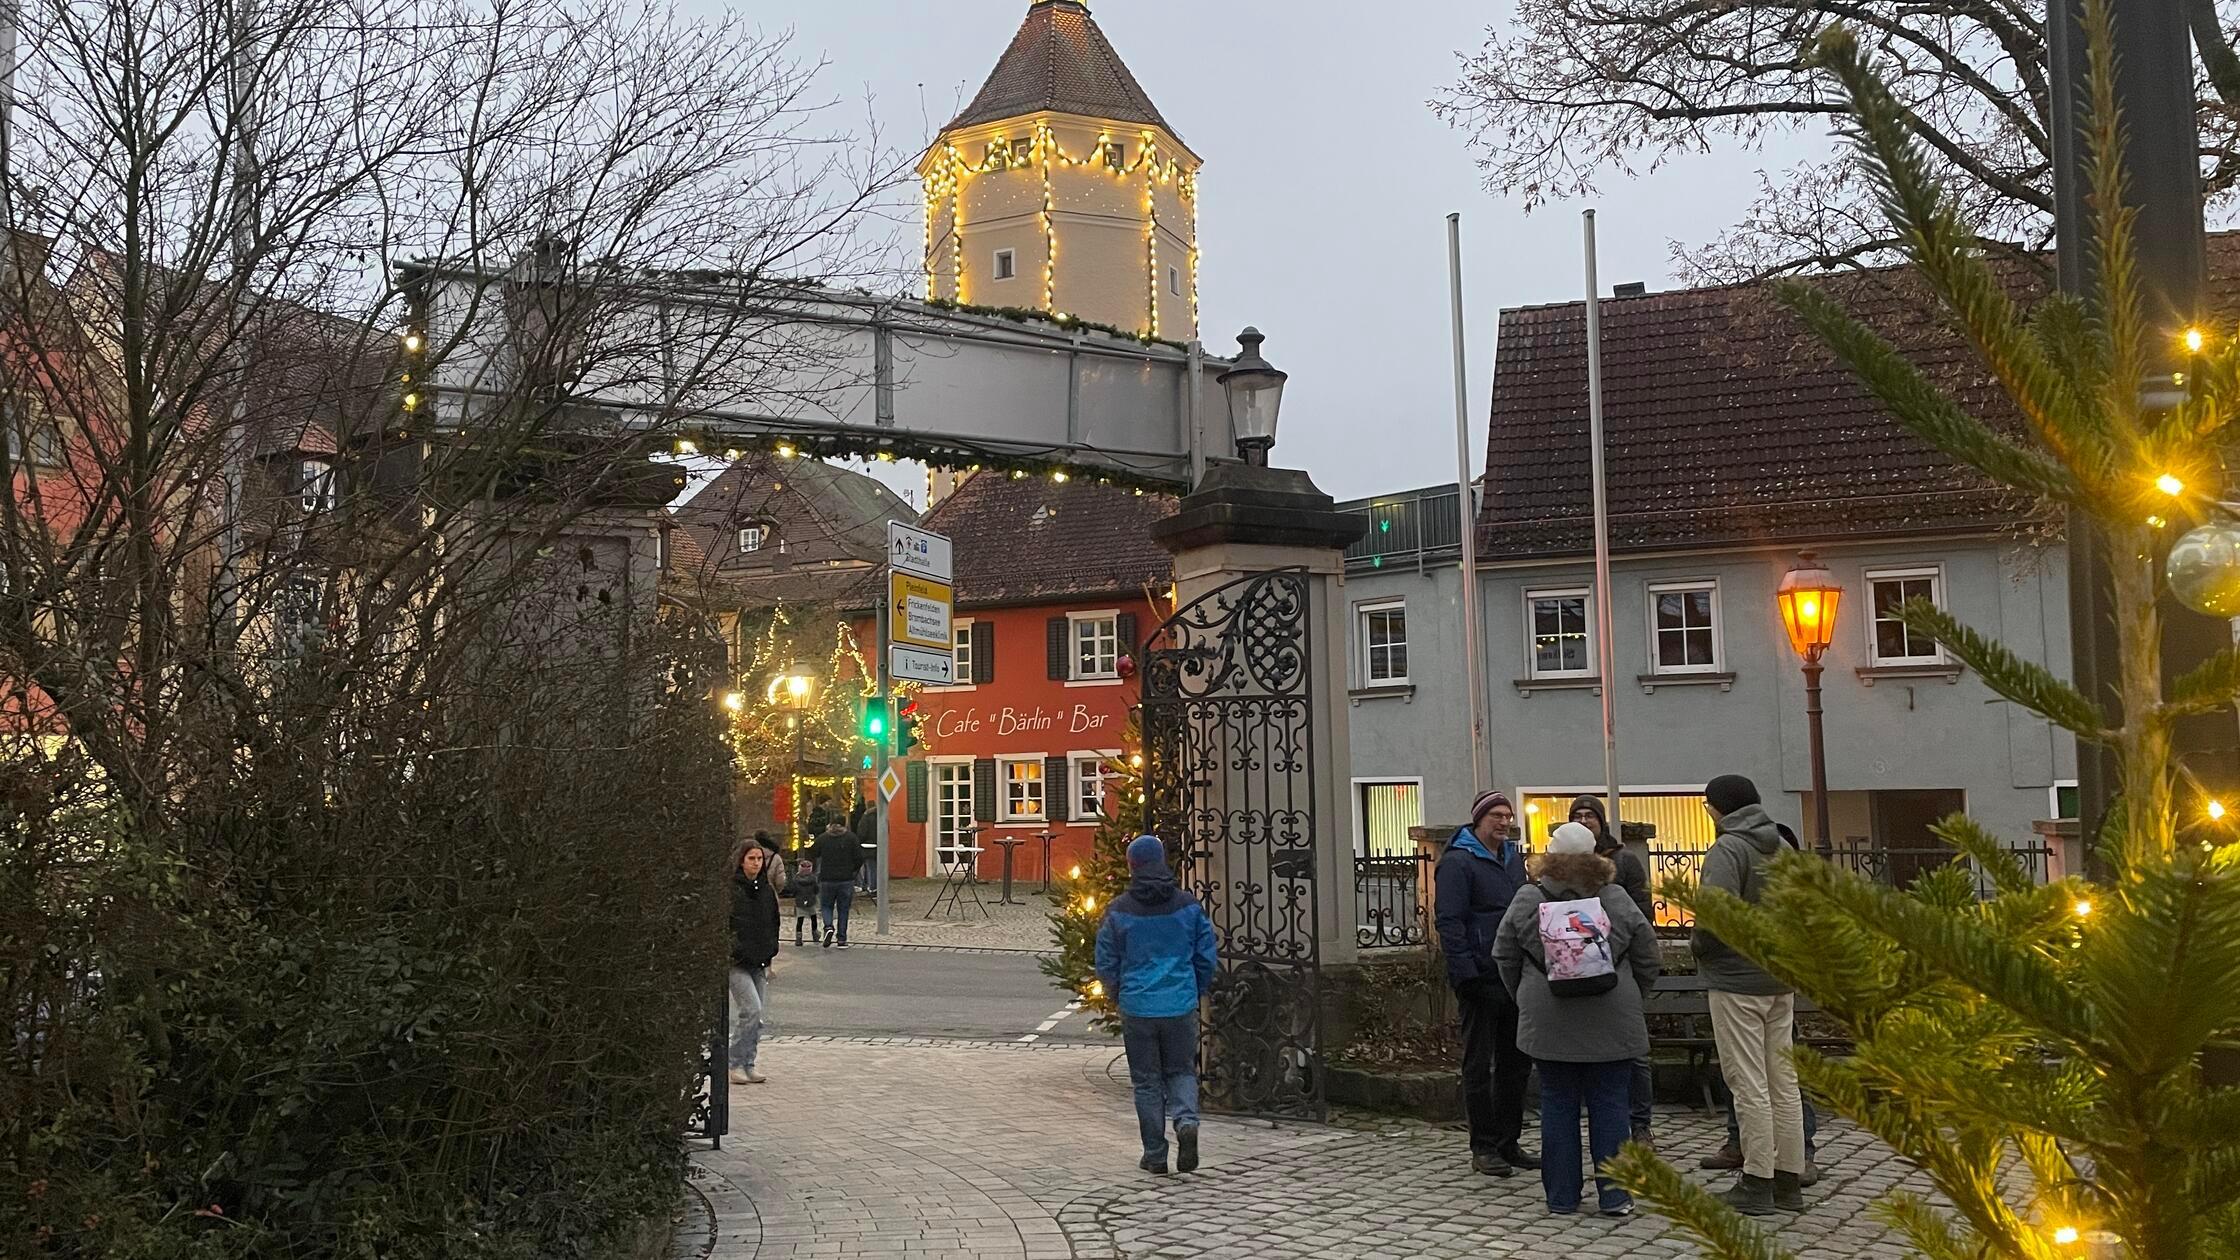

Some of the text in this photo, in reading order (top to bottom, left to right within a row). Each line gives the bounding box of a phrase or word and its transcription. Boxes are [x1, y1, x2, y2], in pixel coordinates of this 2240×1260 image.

[908, 611, 941, 627] Brombachsee
[937, 708, 980, 737] Cafe
[1069, 704, 1109, 733] Bar
